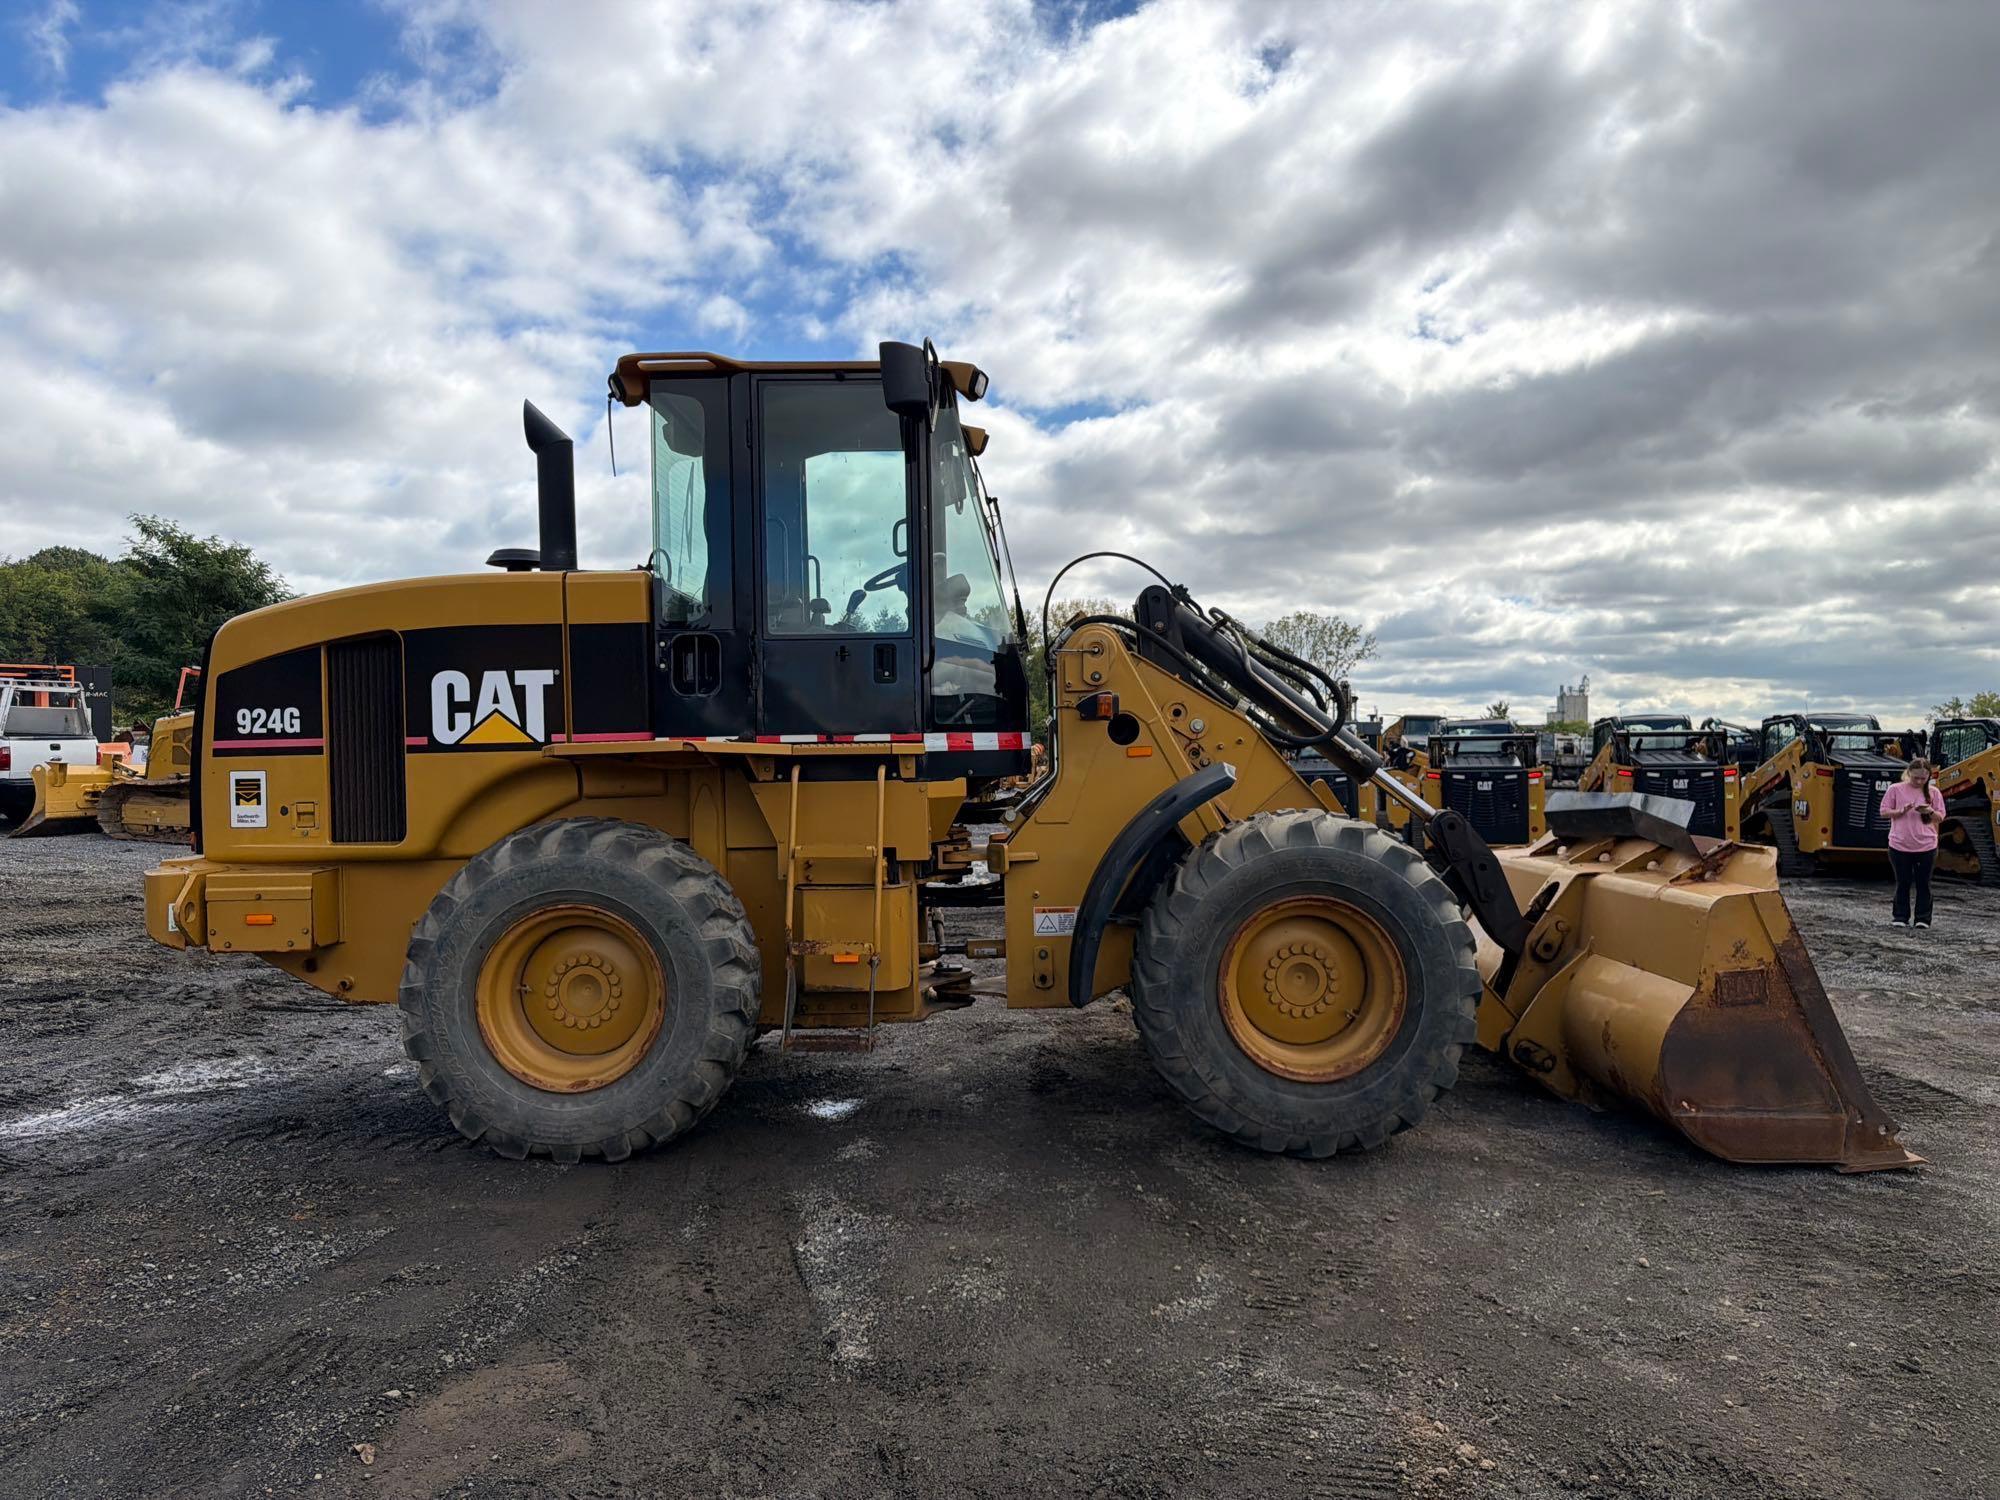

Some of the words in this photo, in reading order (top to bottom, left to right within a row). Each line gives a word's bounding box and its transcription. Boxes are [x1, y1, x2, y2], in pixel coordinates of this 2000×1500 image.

[431, 669, 554, 745] CAT
[236, 707, 301, 734] 924G
[1477, 781, 1494, 791] CAT
[1673, 779, 1689, 789] CAT
[1794, 800, 1808, 816] CAT
